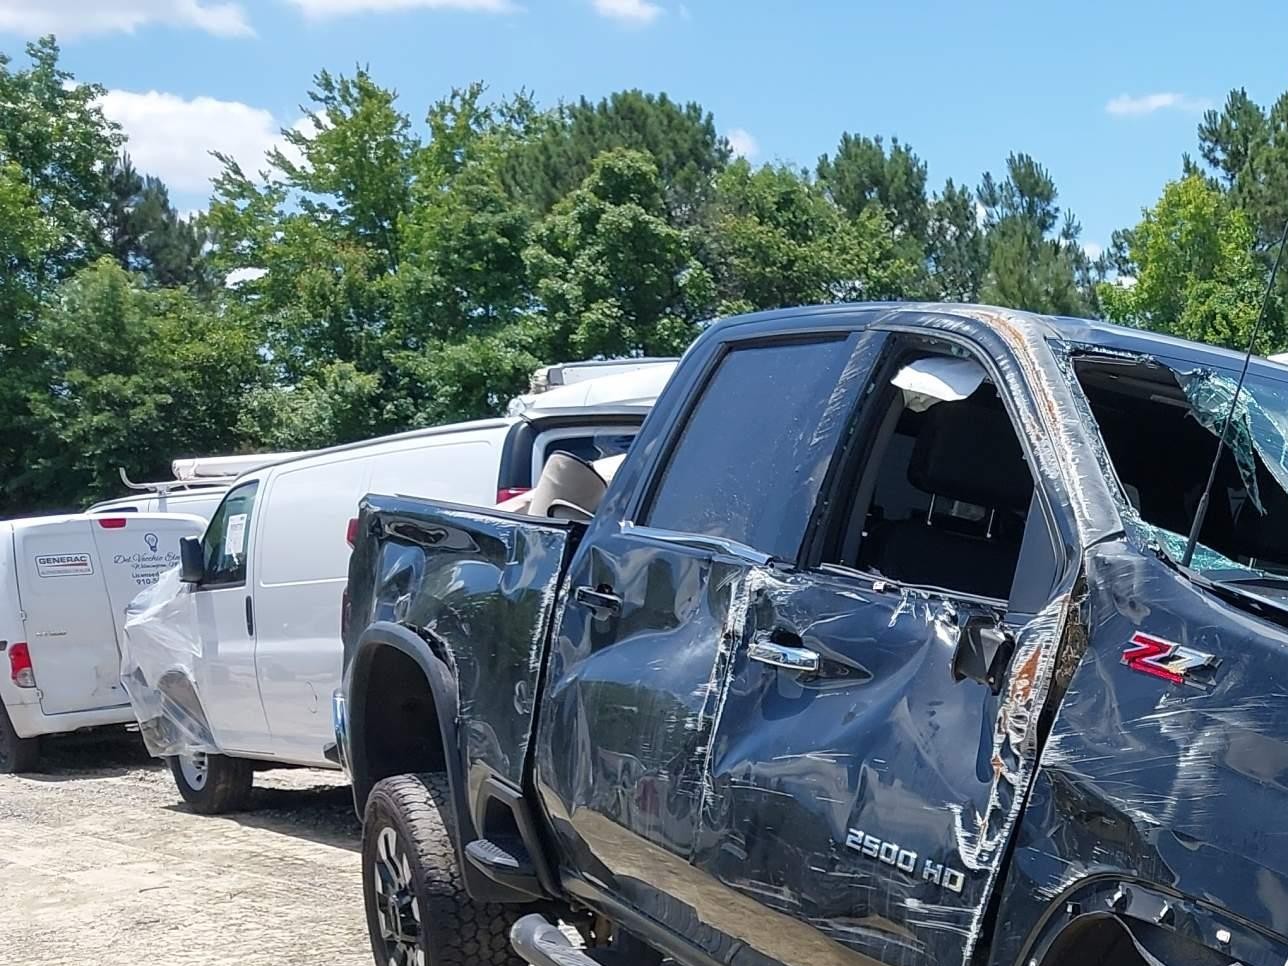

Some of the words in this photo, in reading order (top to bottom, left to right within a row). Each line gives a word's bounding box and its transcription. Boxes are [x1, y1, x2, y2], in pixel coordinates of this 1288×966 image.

[38, 556, 88, 565] GENERAC
[845, 827, 918, 873] 2500
[922, 859, 965, 893] HD
